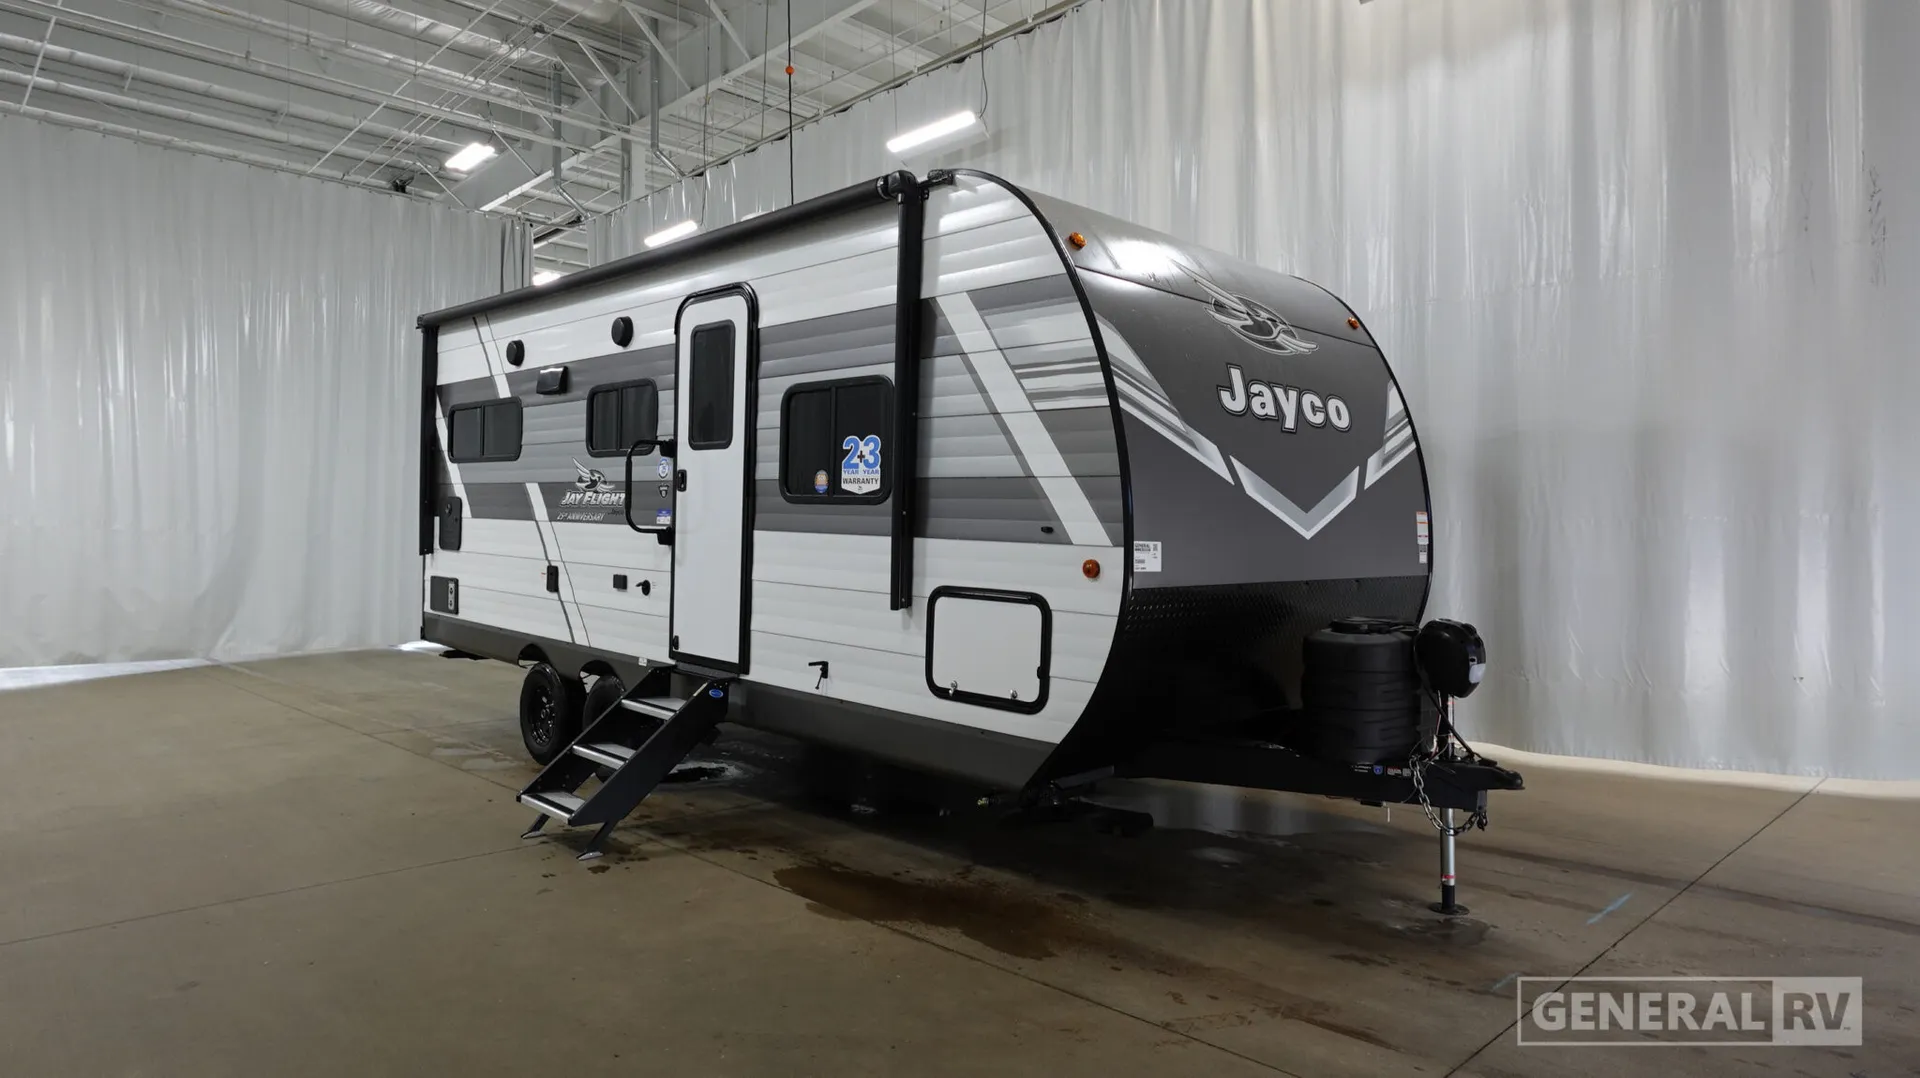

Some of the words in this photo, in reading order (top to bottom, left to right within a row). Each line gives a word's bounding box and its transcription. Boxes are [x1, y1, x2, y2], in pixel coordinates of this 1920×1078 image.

[1217, 363, 1351, 433] Jayco
[843, 477, 879, 485] WARRANTY
[561, 491, 584, 505] JAY
